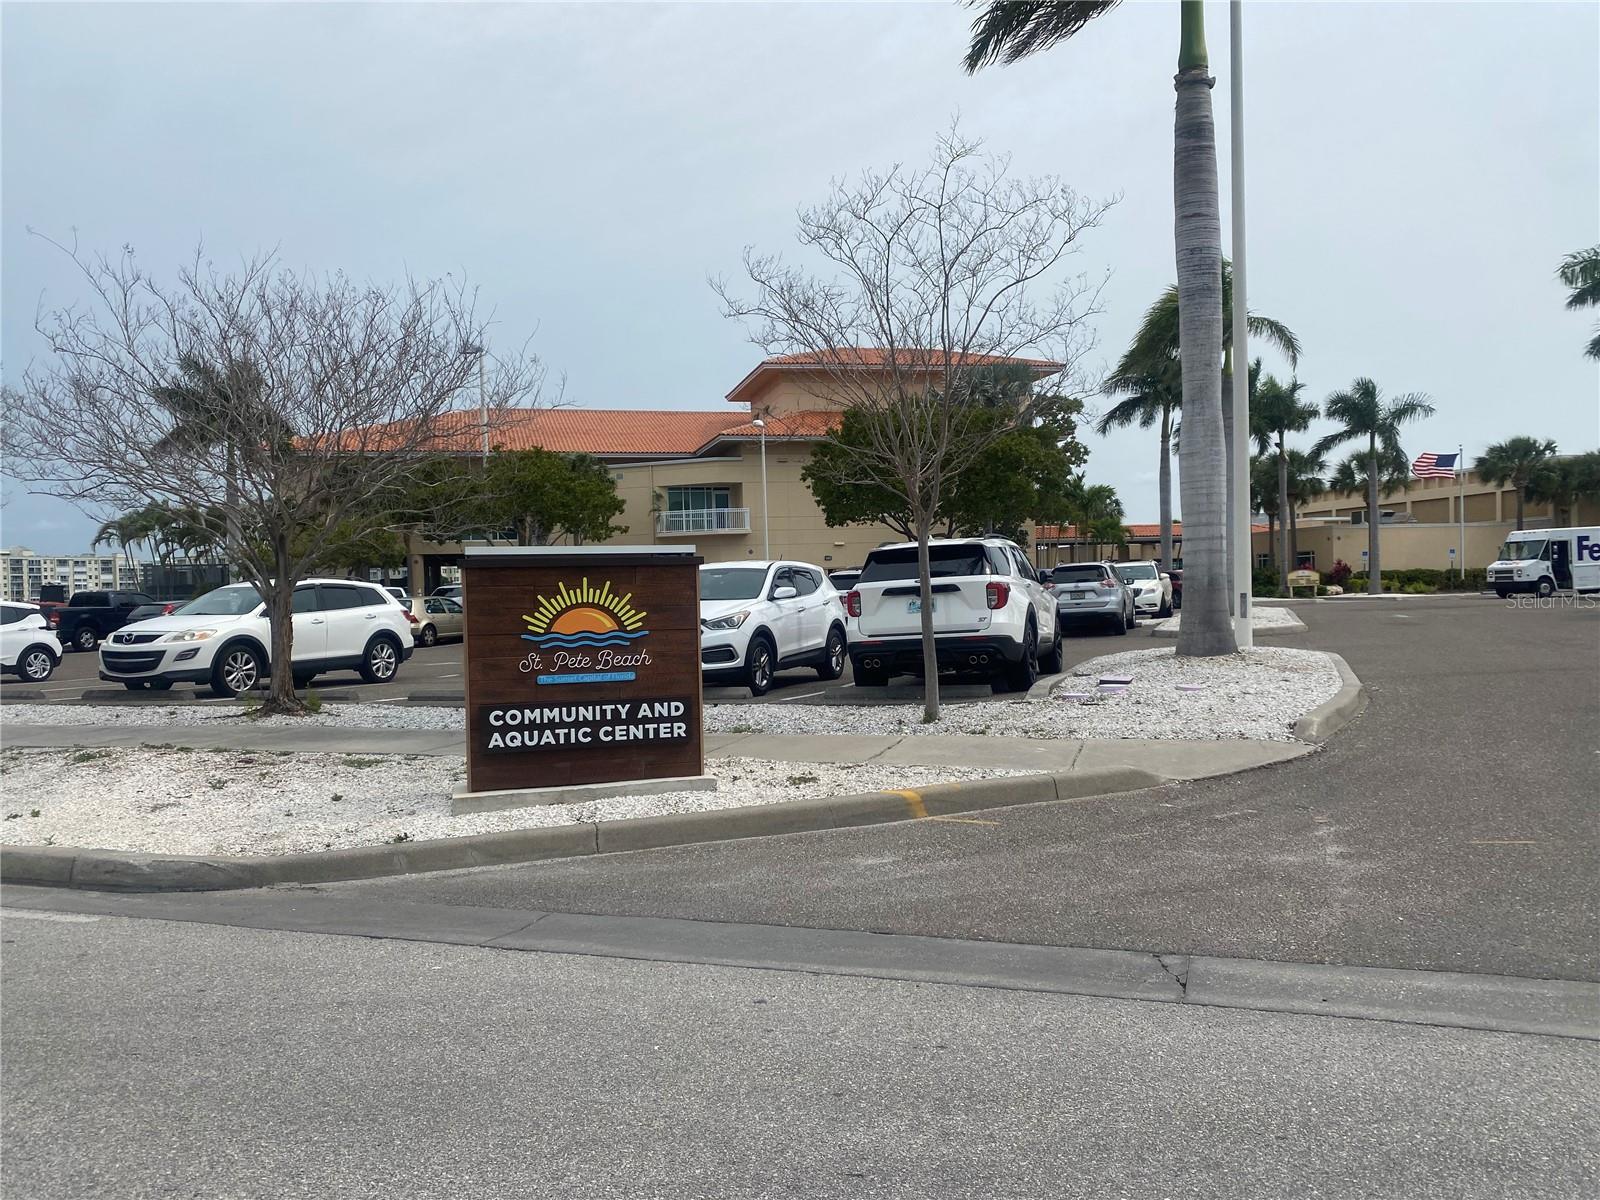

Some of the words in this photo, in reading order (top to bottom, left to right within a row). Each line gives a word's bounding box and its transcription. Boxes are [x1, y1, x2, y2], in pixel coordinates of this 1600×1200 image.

[519, 652, 543, 673] St.
[550, 651, 592, 672] Pete
[595, 649, 652, 670] Beach
[489, 704, 631, 726] COMMUNITY
[637, 701, 685, 718] AND
[488, 727, 592, 749] AQUATIC
[599, 722, 687, 742] CENTER
